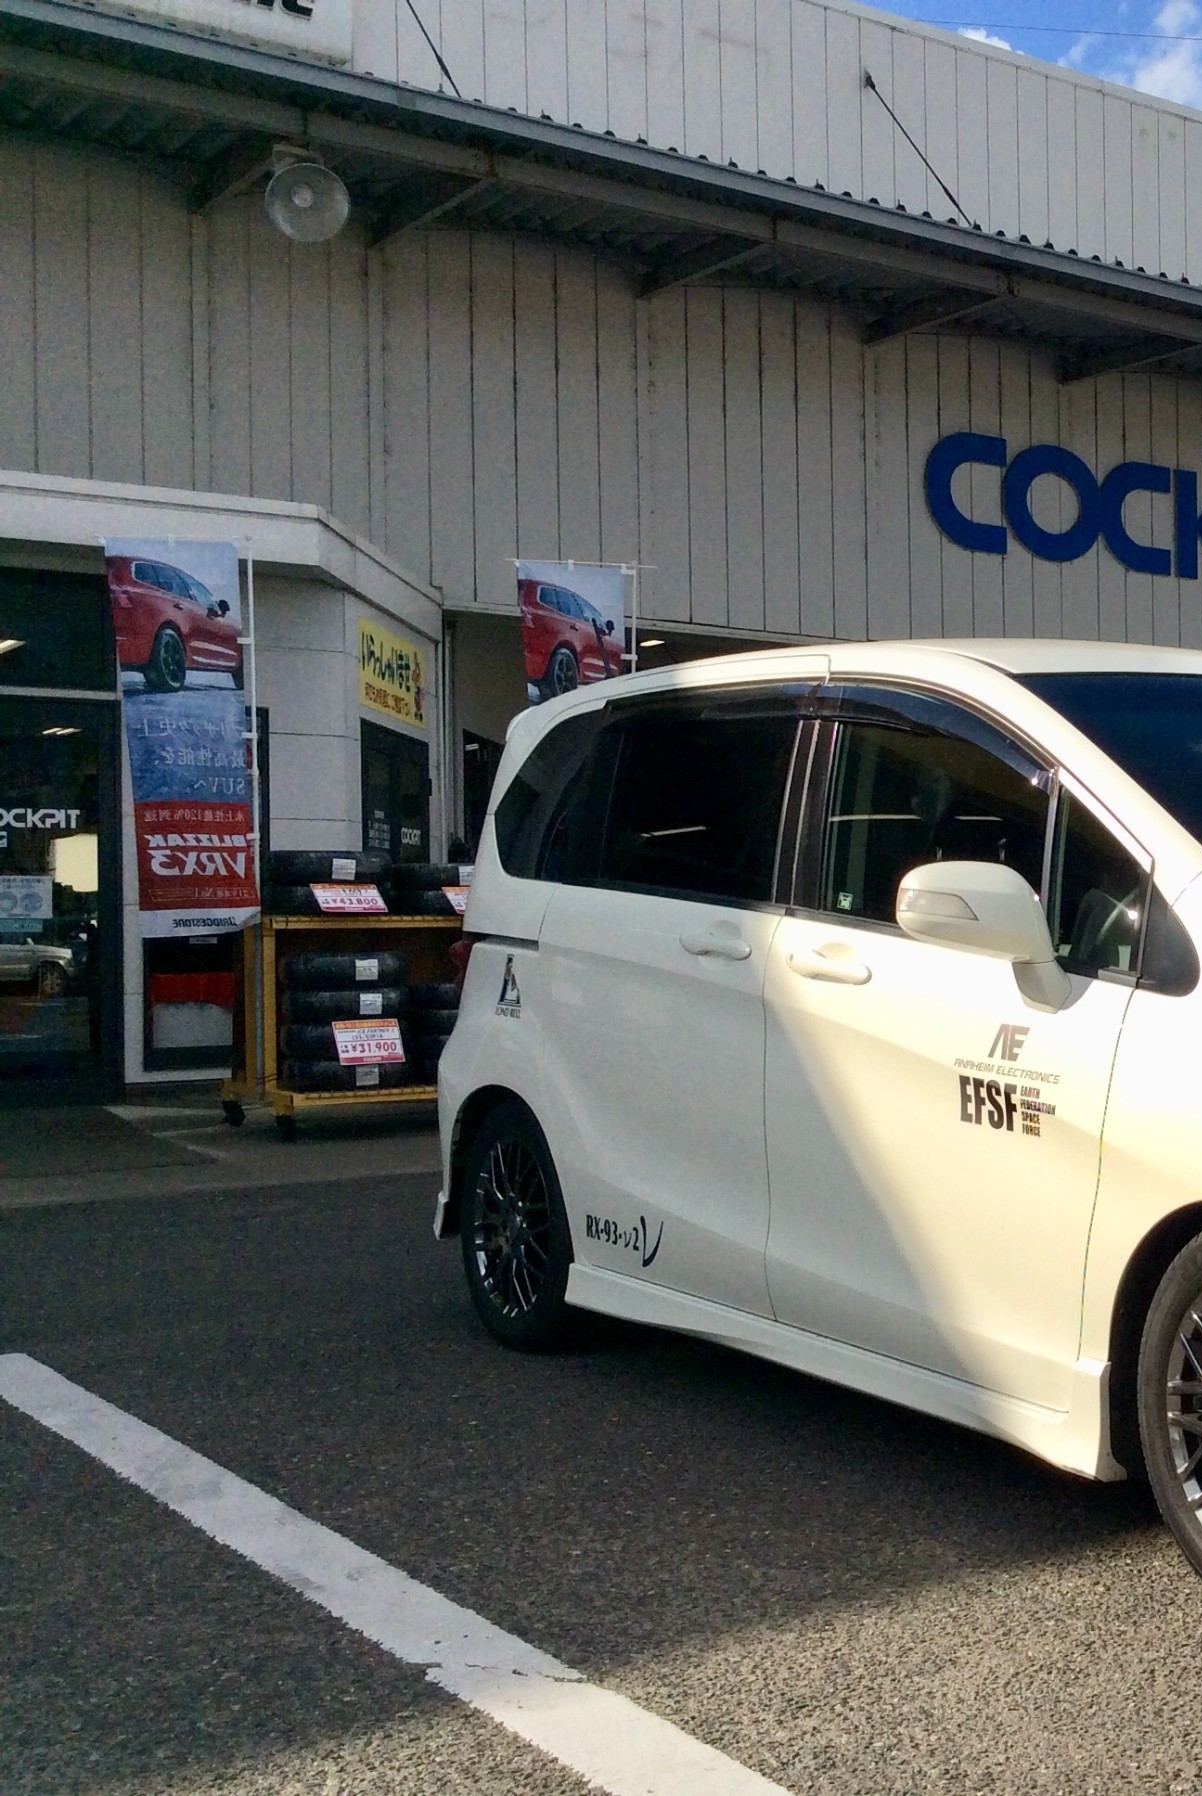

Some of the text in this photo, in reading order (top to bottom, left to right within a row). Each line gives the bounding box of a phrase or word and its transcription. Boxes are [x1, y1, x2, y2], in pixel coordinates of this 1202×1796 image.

[954, 1058, 1061, 1084] ANAHEIM ELECTRONICS
[1020, 1085, 1041, 1099] EARTH
[959, 1074, 1017, 1132] EFSF
[1020, 1098, 1057, 1115] FEDERATION
[1021, 1111, 1041, 1125] SPACE
[1022, 1123, 1041, 1137] FORCE
